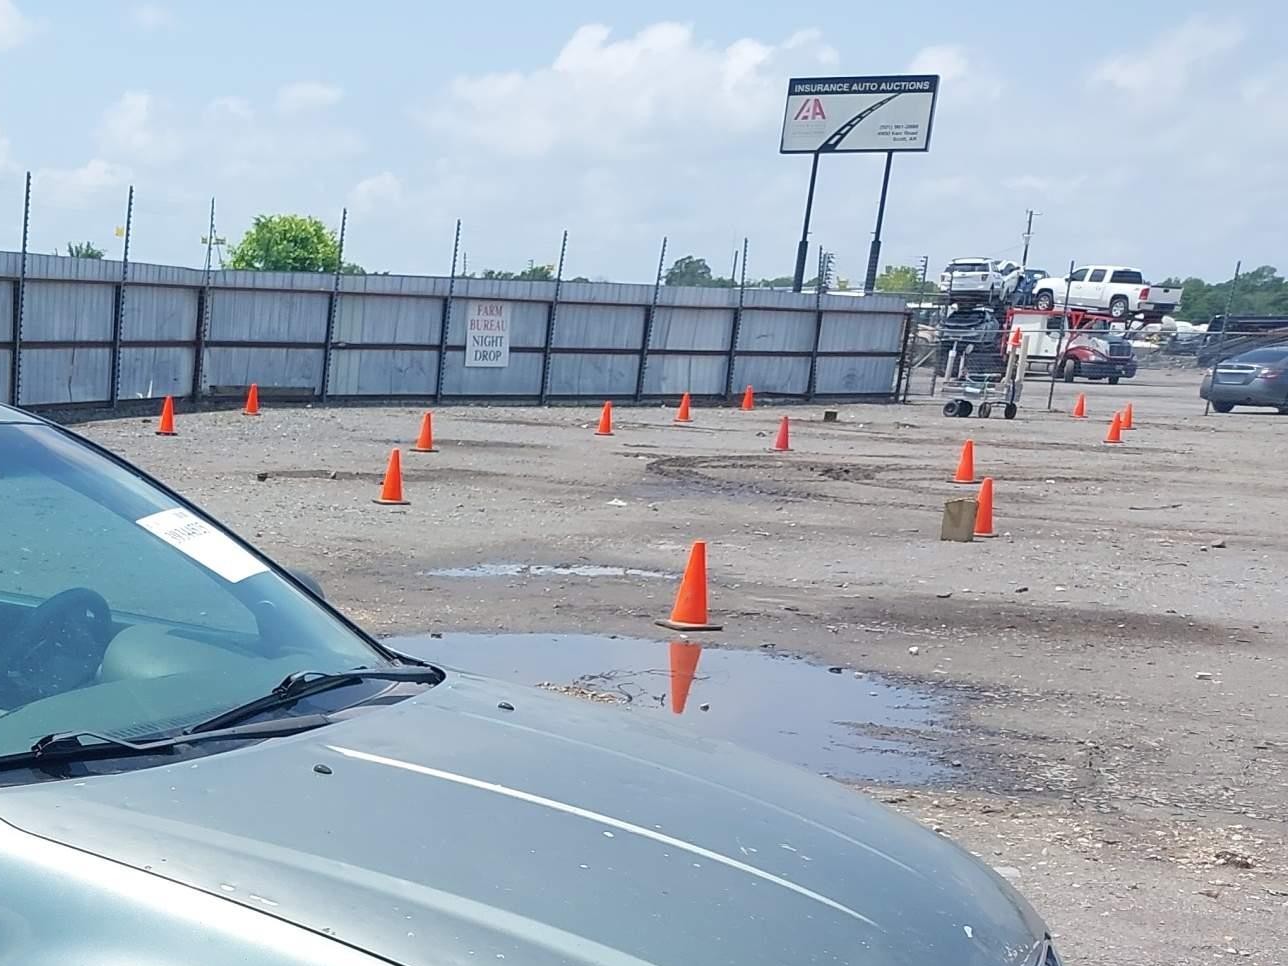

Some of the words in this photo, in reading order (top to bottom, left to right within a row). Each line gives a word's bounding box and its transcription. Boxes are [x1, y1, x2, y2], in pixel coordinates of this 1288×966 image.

[794, 83, 850, 93] INSURANCE
[851, 82, 878, 91] AUTO
[879, 81, 930, 91] AUCTIONS
[477, 304, 503, 317] FARM
[470, 319, 507, 332] BUREAU
[472, 335, 504, 348] NIGHT
[474, 350, 502, 362] DROP
